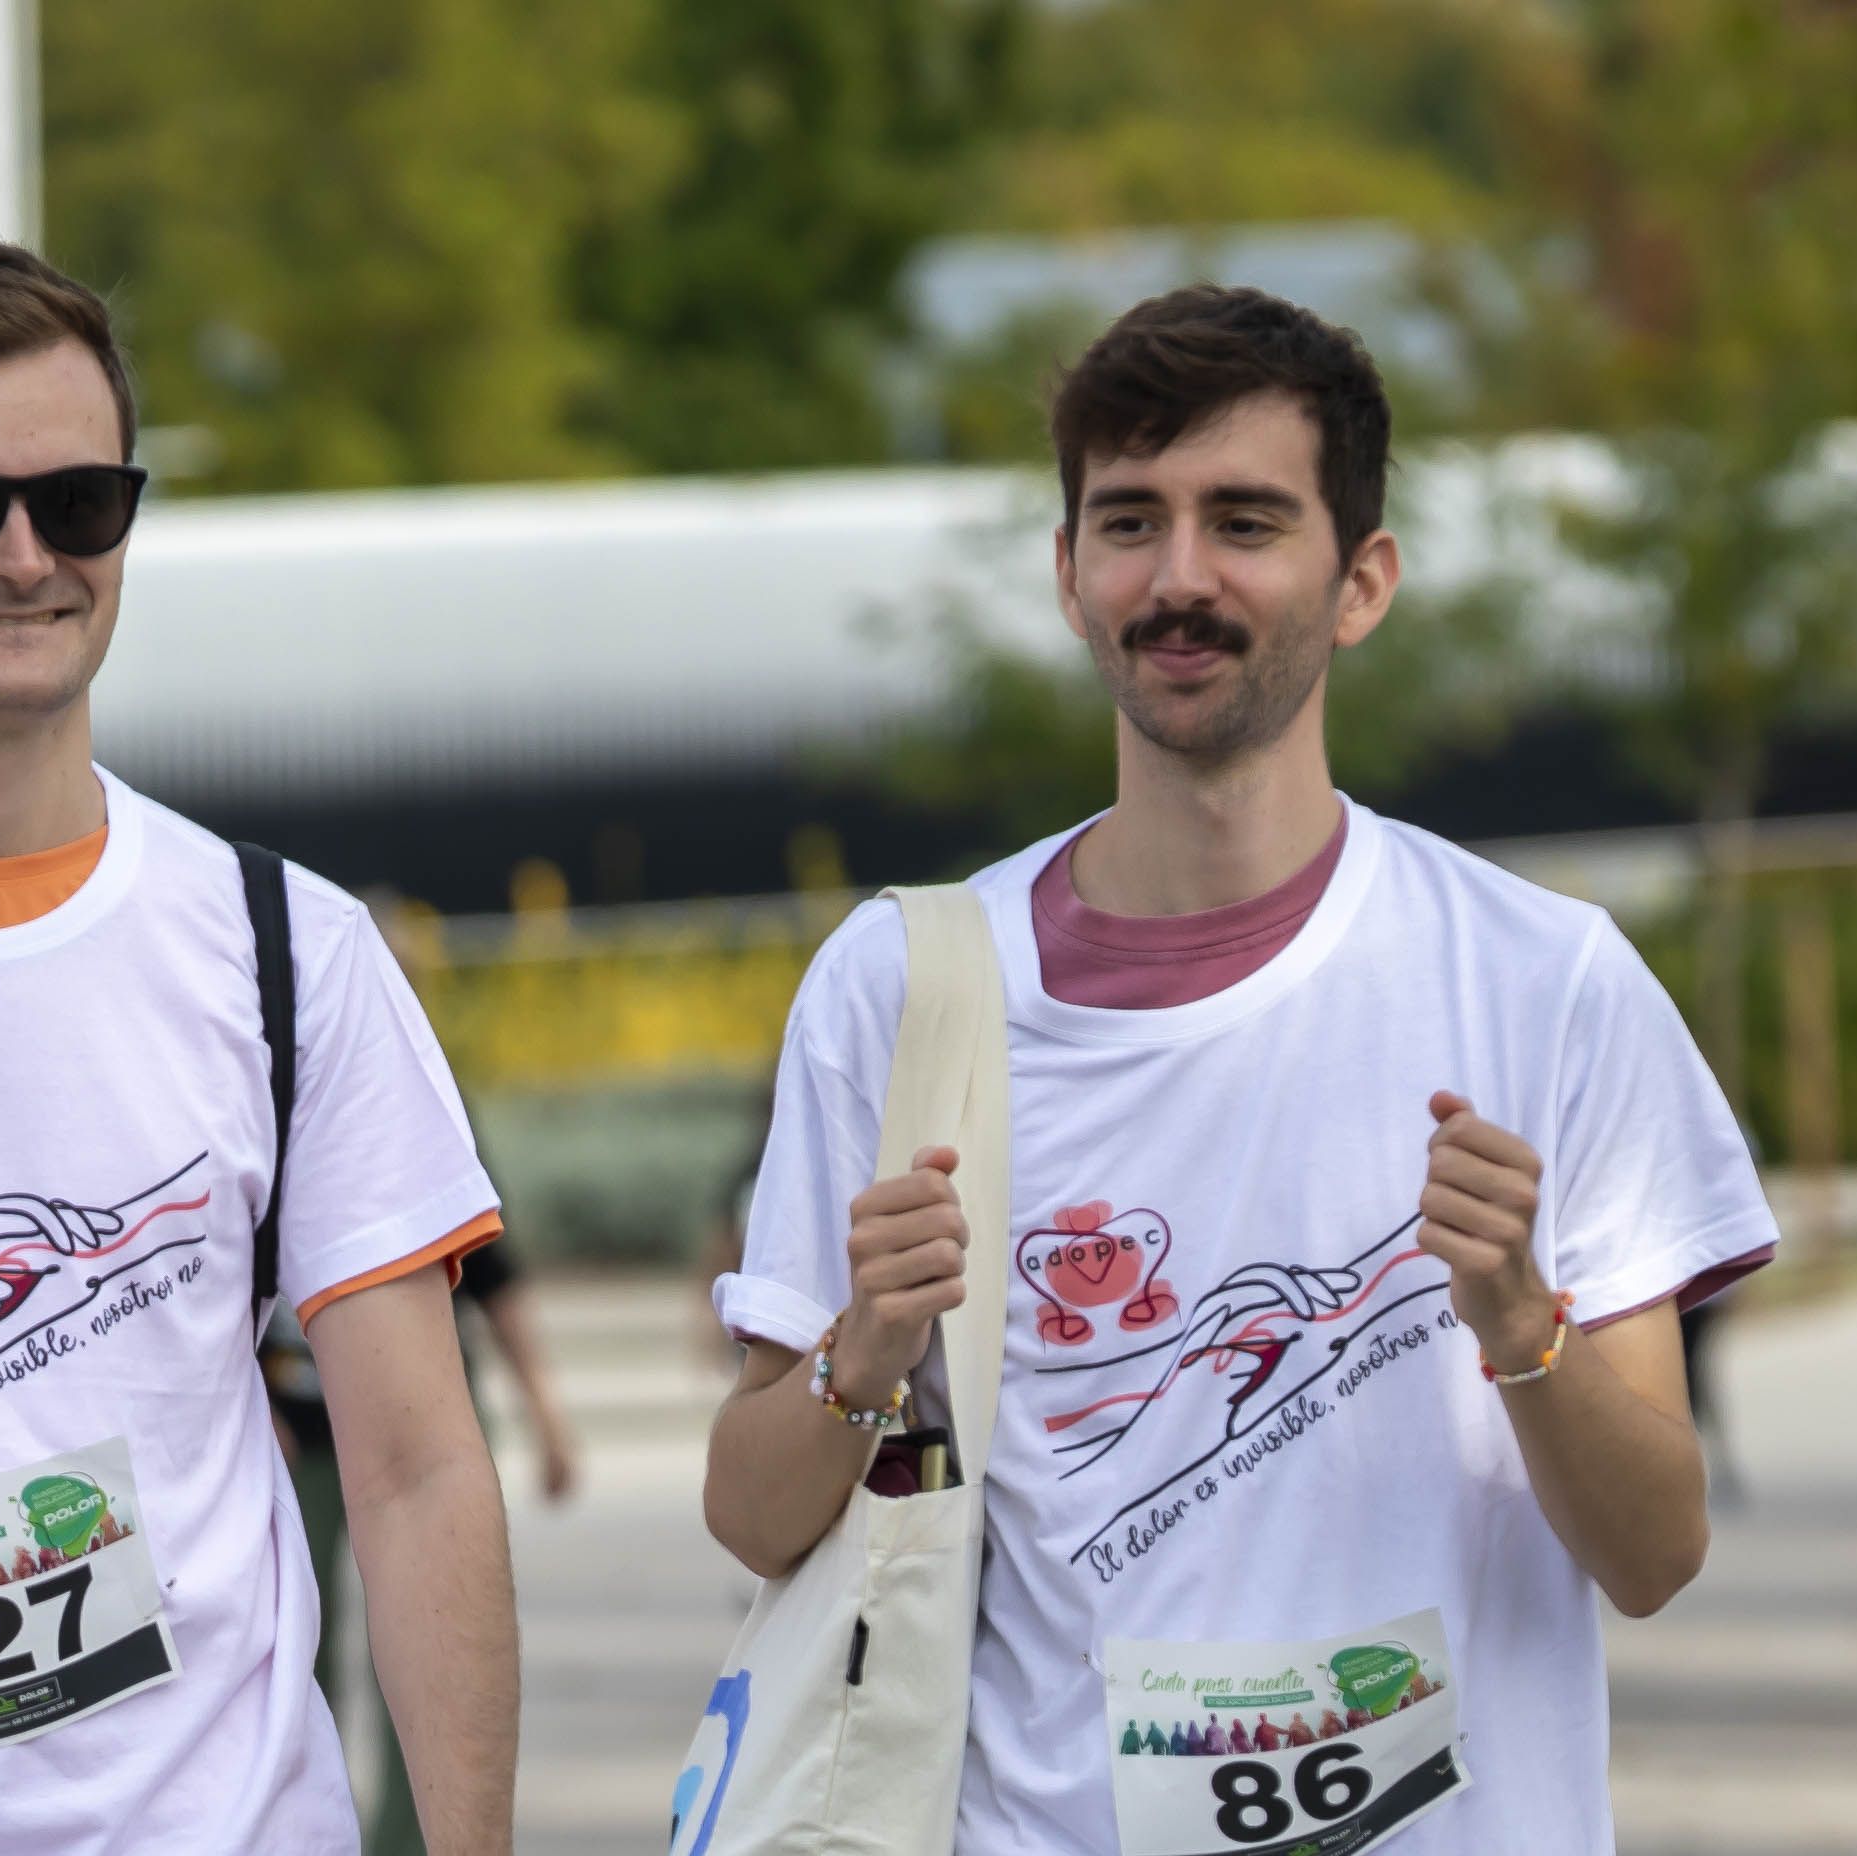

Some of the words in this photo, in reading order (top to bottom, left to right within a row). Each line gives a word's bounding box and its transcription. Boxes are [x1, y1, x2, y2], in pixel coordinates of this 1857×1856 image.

[1026, 1227, 1161, 1271] adopec
[91, 1276, 173, 1336] nosotros
[178, 1256, 204, 1284] no
[1090, 1541, 1123, 1583] El
[1127, 1498, 1190, 1558] dolor
[1195, 1475, 1219, 1501] es
[1337, 1323, 1432, 1397] nosotros
[43, 1493, 102, 1528] DOLOR
[1351, 1658, 1414, 1691] DOLOR
[1210, 1741, 1374, 1843] 86
